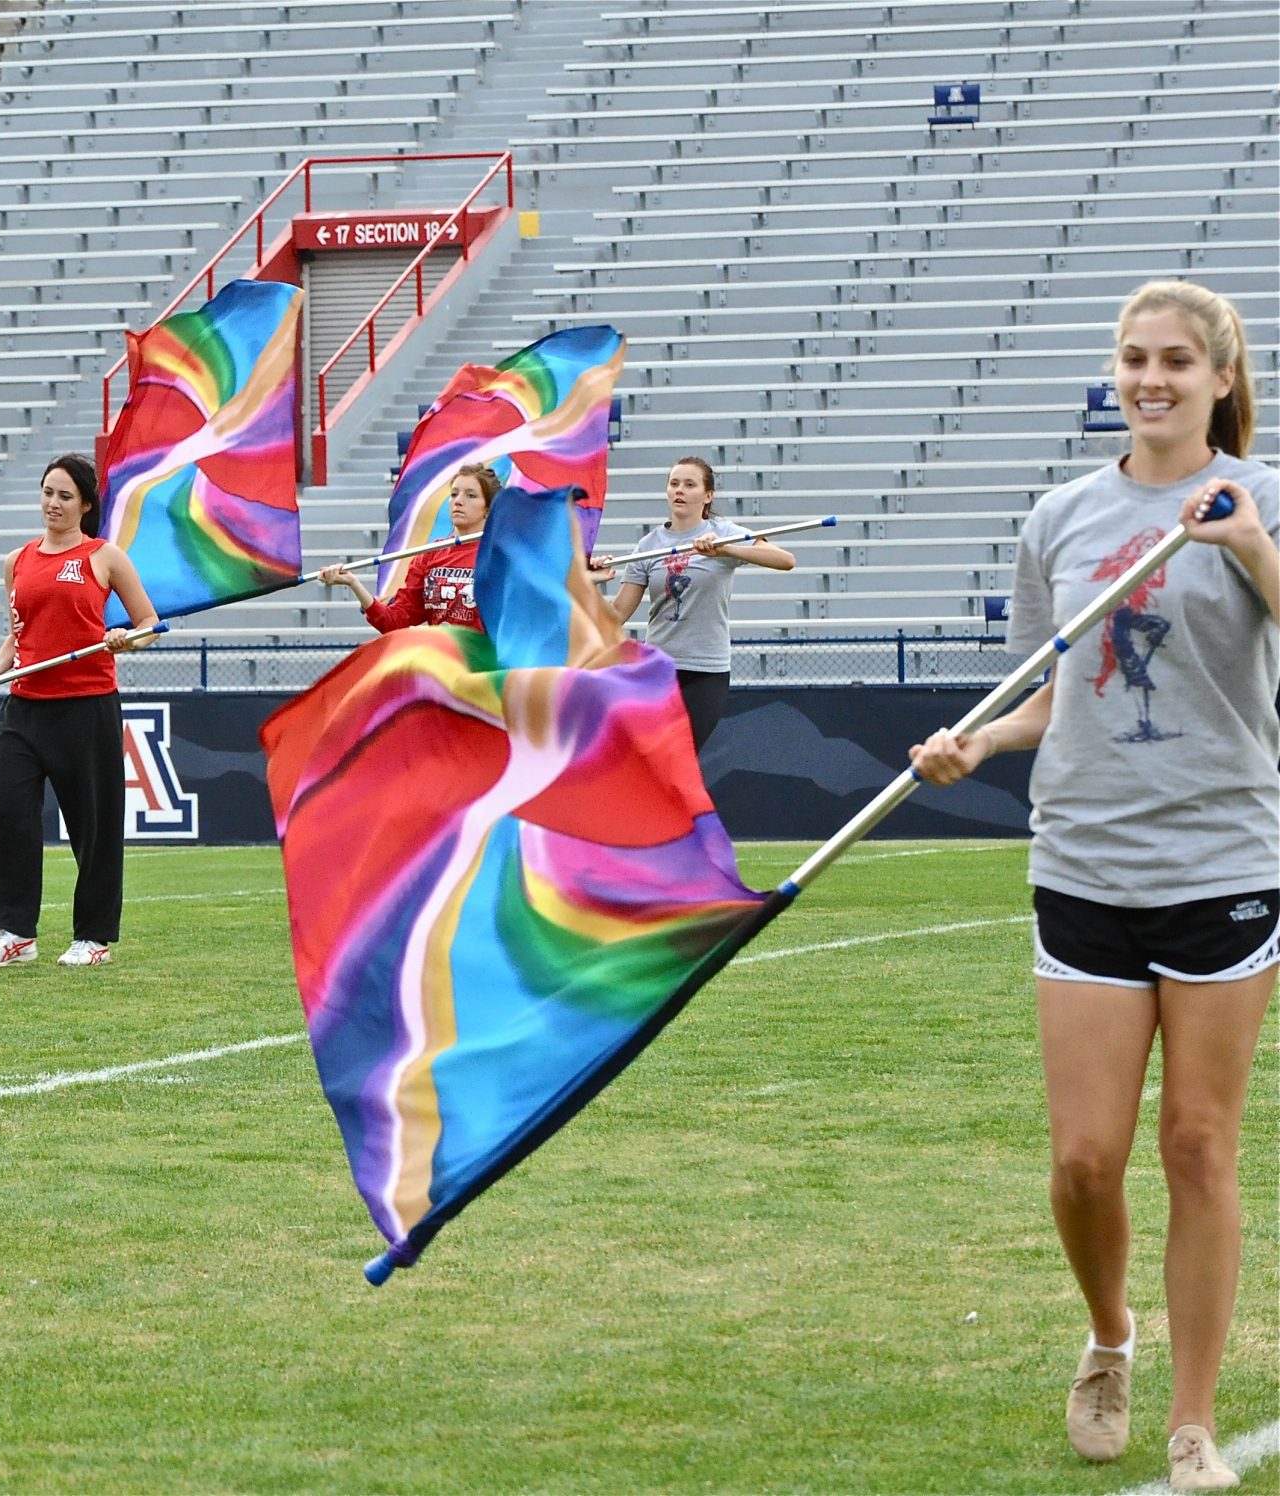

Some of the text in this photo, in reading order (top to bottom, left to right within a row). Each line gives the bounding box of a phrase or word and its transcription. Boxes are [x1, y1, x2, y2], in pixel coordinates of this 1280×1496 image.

[335, 221, 440, 244] 17 SECTION 18
[56, 559, 85, 584] A
